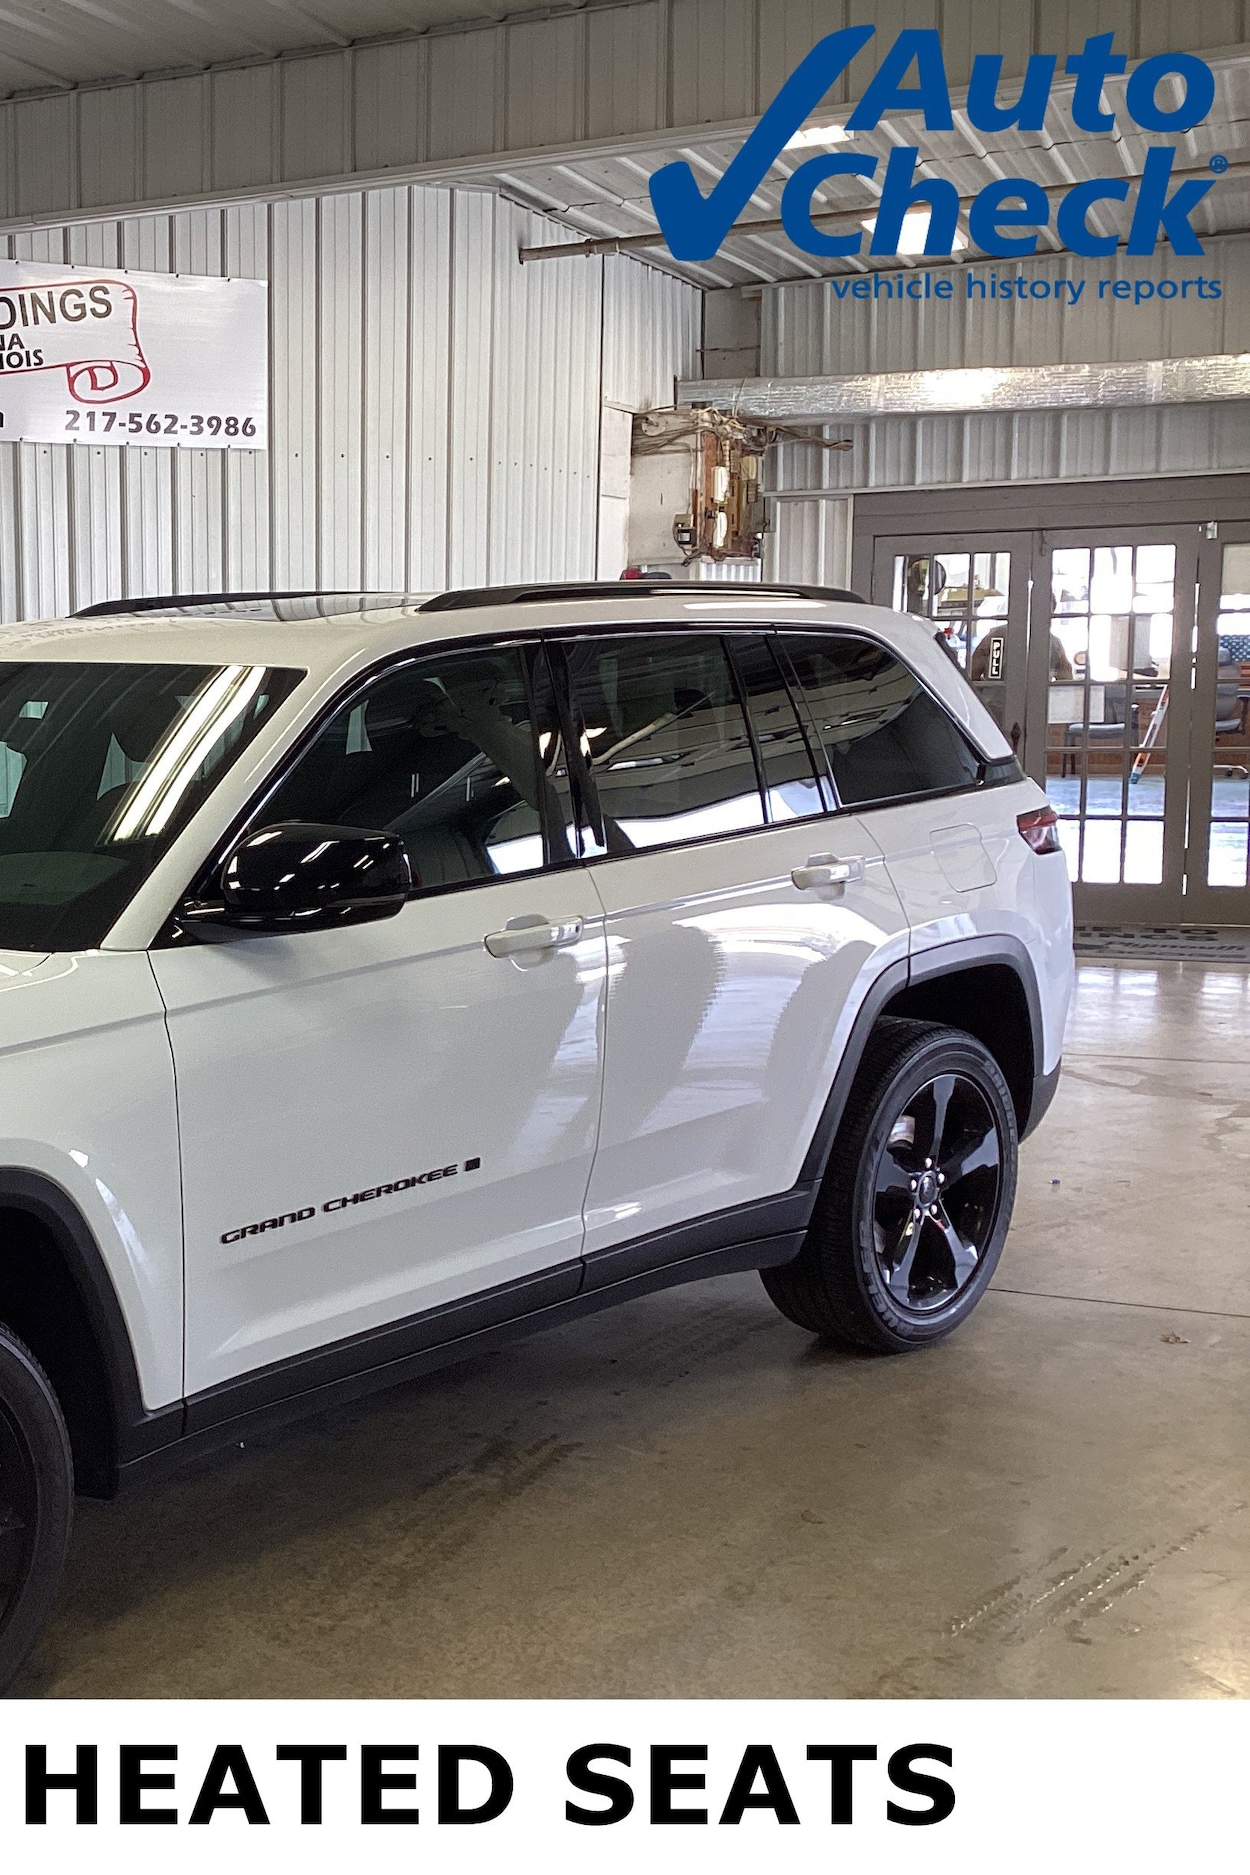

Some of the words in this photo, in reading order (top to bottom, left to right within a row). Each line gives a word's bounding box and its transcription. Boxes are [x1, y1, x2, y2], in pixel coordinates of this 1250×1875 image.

[64, 408, 258, 438] 217-562-3986
[992, 641, 1001, 675] PULL
[220, 1206, 316, 1245] GRAND
[322, 1164, 459, 1214] CHEROKEE
